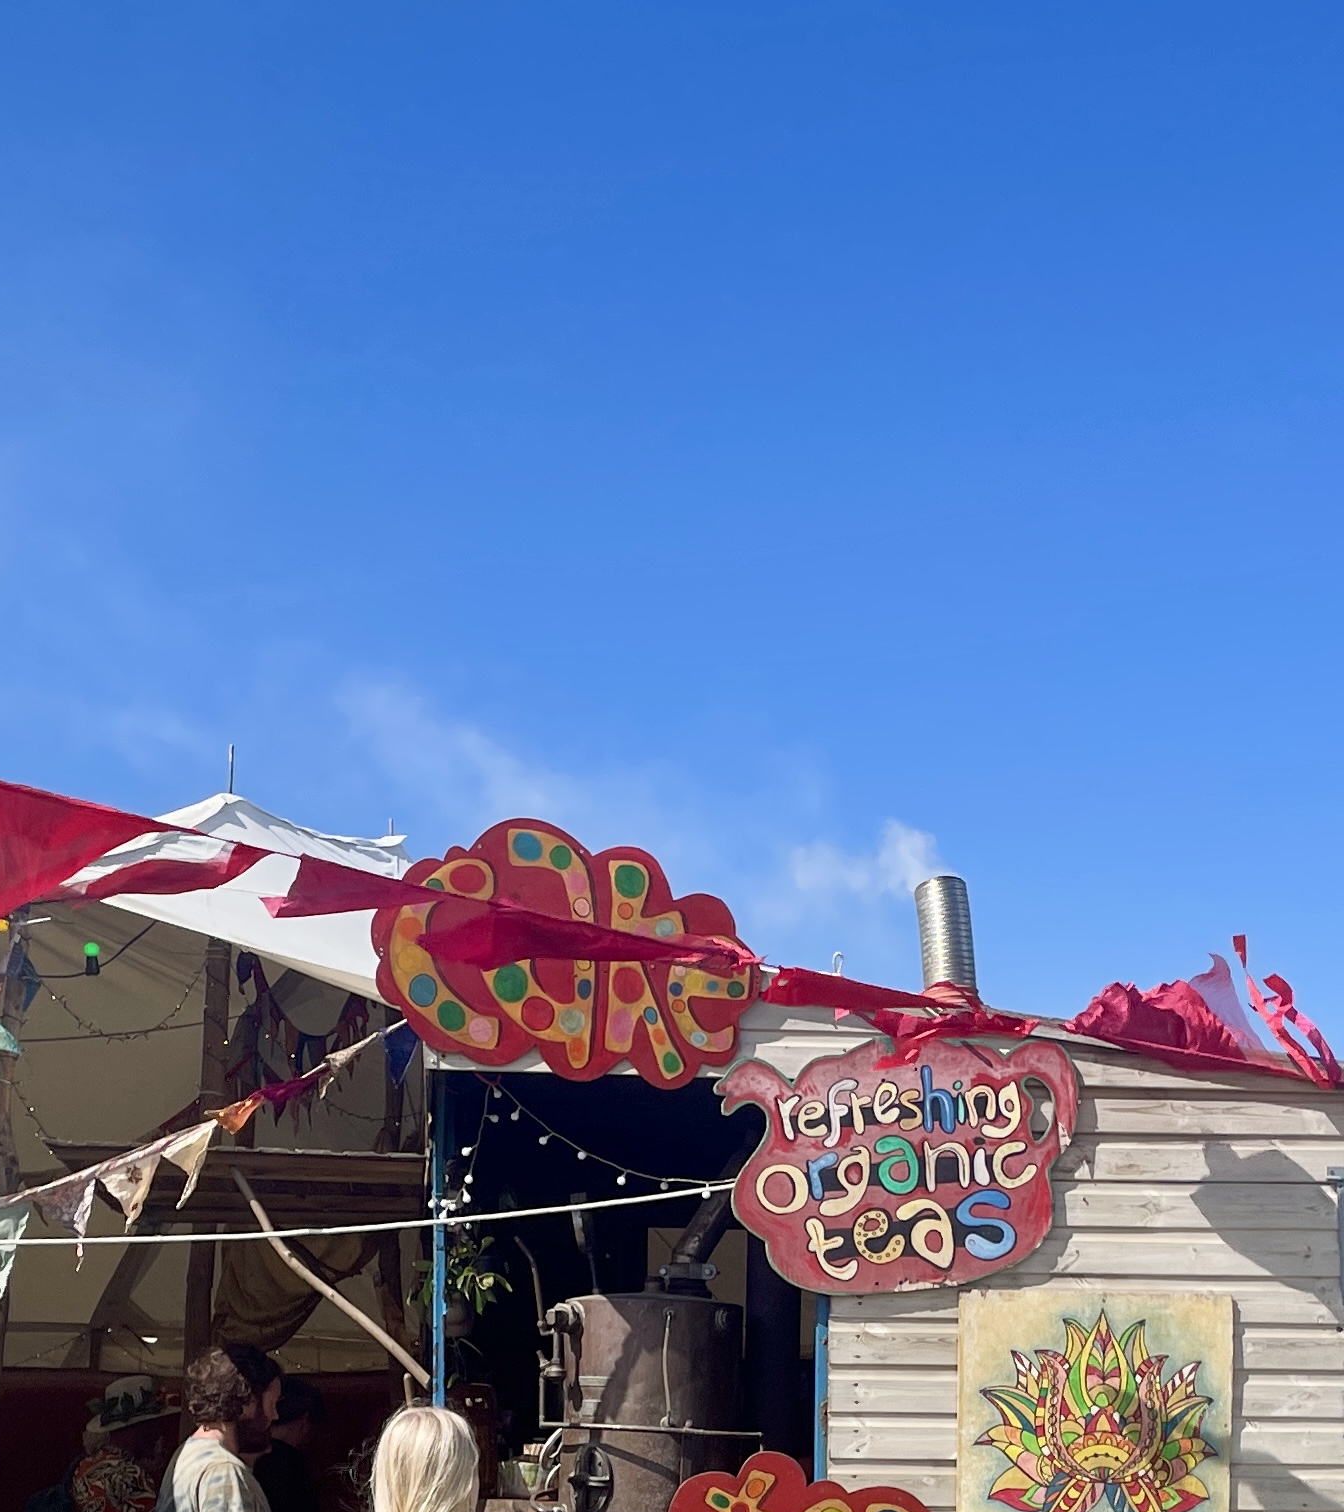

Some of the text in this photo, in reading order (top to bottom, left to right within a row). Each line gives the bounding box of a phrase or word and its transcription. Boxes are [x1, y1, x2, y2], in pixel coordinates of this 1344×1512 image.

[776, 1064, 1022, 1148] refreshing
[755, 1134, 1038, 1217] organic
[805, 1188, 1017, 1281] teas
